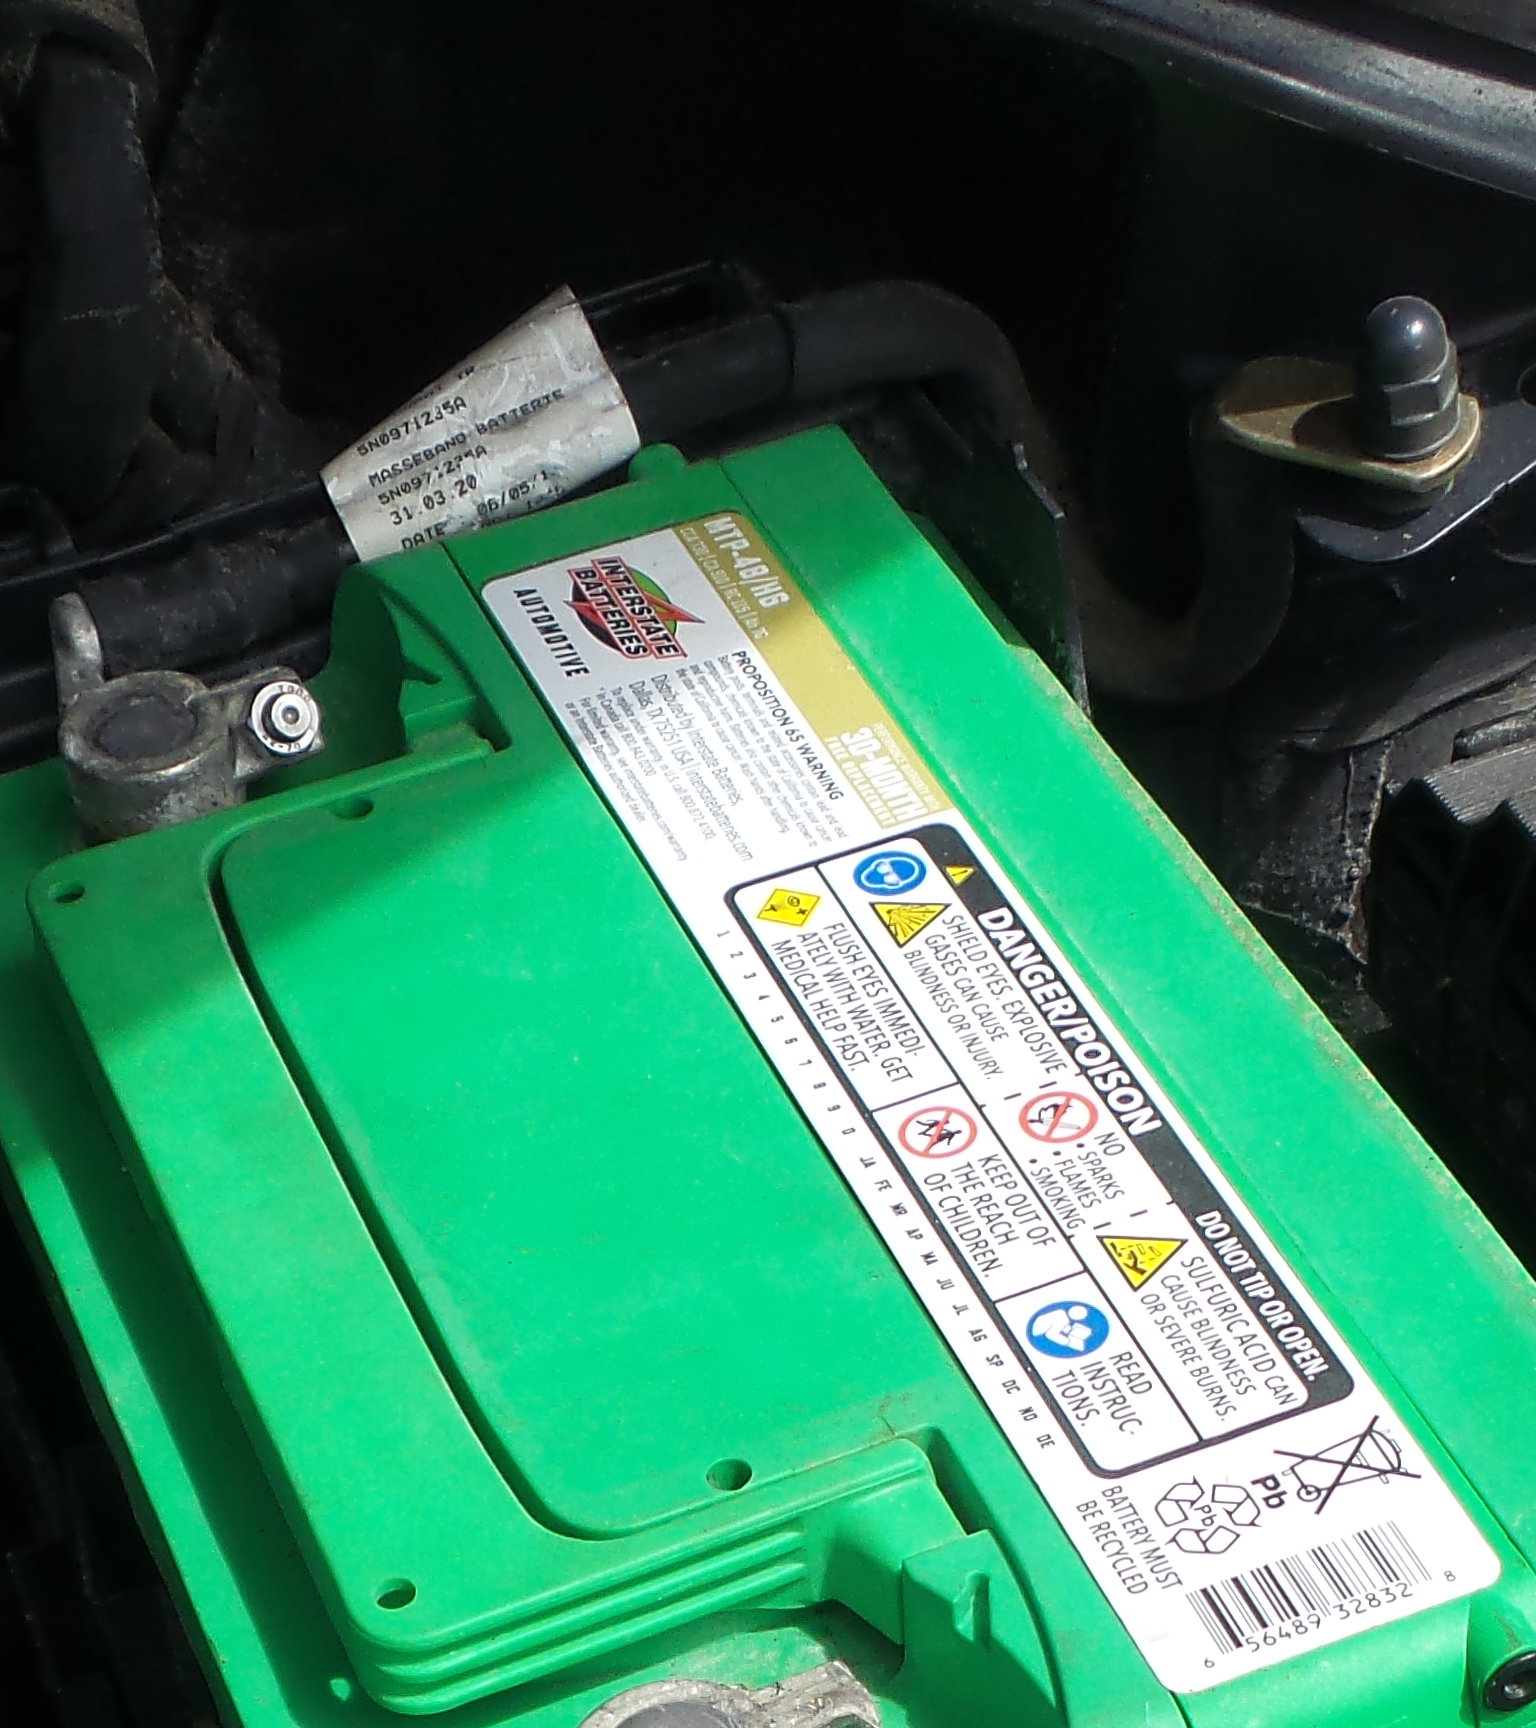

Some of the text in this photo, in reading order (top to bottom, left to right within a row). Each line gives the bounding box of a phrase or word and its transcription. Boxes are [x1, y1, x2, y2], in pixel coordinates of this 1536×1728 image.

[368, 388, 564, 489] MASSEBAND BATTERIE
[574, 566, 648, 657] BATTERIES
[597, 556, 679, 658] INTERSTATE
[699, 513, 792, 611] MTP-48/H6
[512, 584, 589, 680] AUTOMOTIVE
[625, 679, 759, 861] Dallas, TX 75251 USA interstatebatteries.com
[649, 673, 749, 807] Distributed by Interstate Batteries,
[730, 649, 845, 801] PROPOSITION 65 WARNING
[837, 724, 929, 823] 30-MONTH
[823, 735, 896, 827] FREE REPLACEMENT
[769, 938, 871, 1072] MEDICAL HELP FAST.
[795, 929, 912, 1084] ATELY WITH WATER. GET
[822, 921, 928, 1059] FLUSH EYES IMMEDI-
[901, 948, 1004, 1080] BLINDNESS OR INJURY.
[921, 932, 1009, 1042] GASES CAN CAUSE
[940, 913, 1068, 1075] SHIELD EYES. EXPLOSIVE
[973, 904, 1163, 1138] DANGER/POISON
[714, 929, 1056, 1449] 1 2 3 4 5 6 7 8 9 0 JA FE MR AP MA JU JL AG SP OC NO DE
[1052, 1157, 1101, 1209] FLAMES
[1076, 1149, 1124, 1201] SPARKS
[1092, 1130, 1126, 1158] NO
[921, 1171, 1005, 1278] OF CHILDREN.
[948, 1161, 1019, 1245] THE REACH
[976, 1152, 1056, 1250] KEEP OUT OF
[1029, 1165, 1086, 1230] SMOKING
[1158, 1272, 1256, 1396] CAUSE BLINDNESS
[1179, 1254, 1297, 1406] SULFURIC ACID CAN
[1193, 1209, 1333, 1382] DO NOT TIP OR OPEN.
[1050, 1369, 1103, 1427] TIONS.
[1079, 1360, 1146, 1437] INSTRUC-
[1108, 1349, 1154, 1396] READ
[1137, 1291, 1240, 1421] OR SEVERE BURNS.
[1099, 1484, 1184, 1592] BATTERY MUST
[1193, 1503, 1220, 1528] Pb
[1249, 1472, 1293, 1510] Pb
[1074, 1499, 1151, 1596] BE RECYCLED
[1200, 1569, 1457, 1669] 6 56489 32832 8
